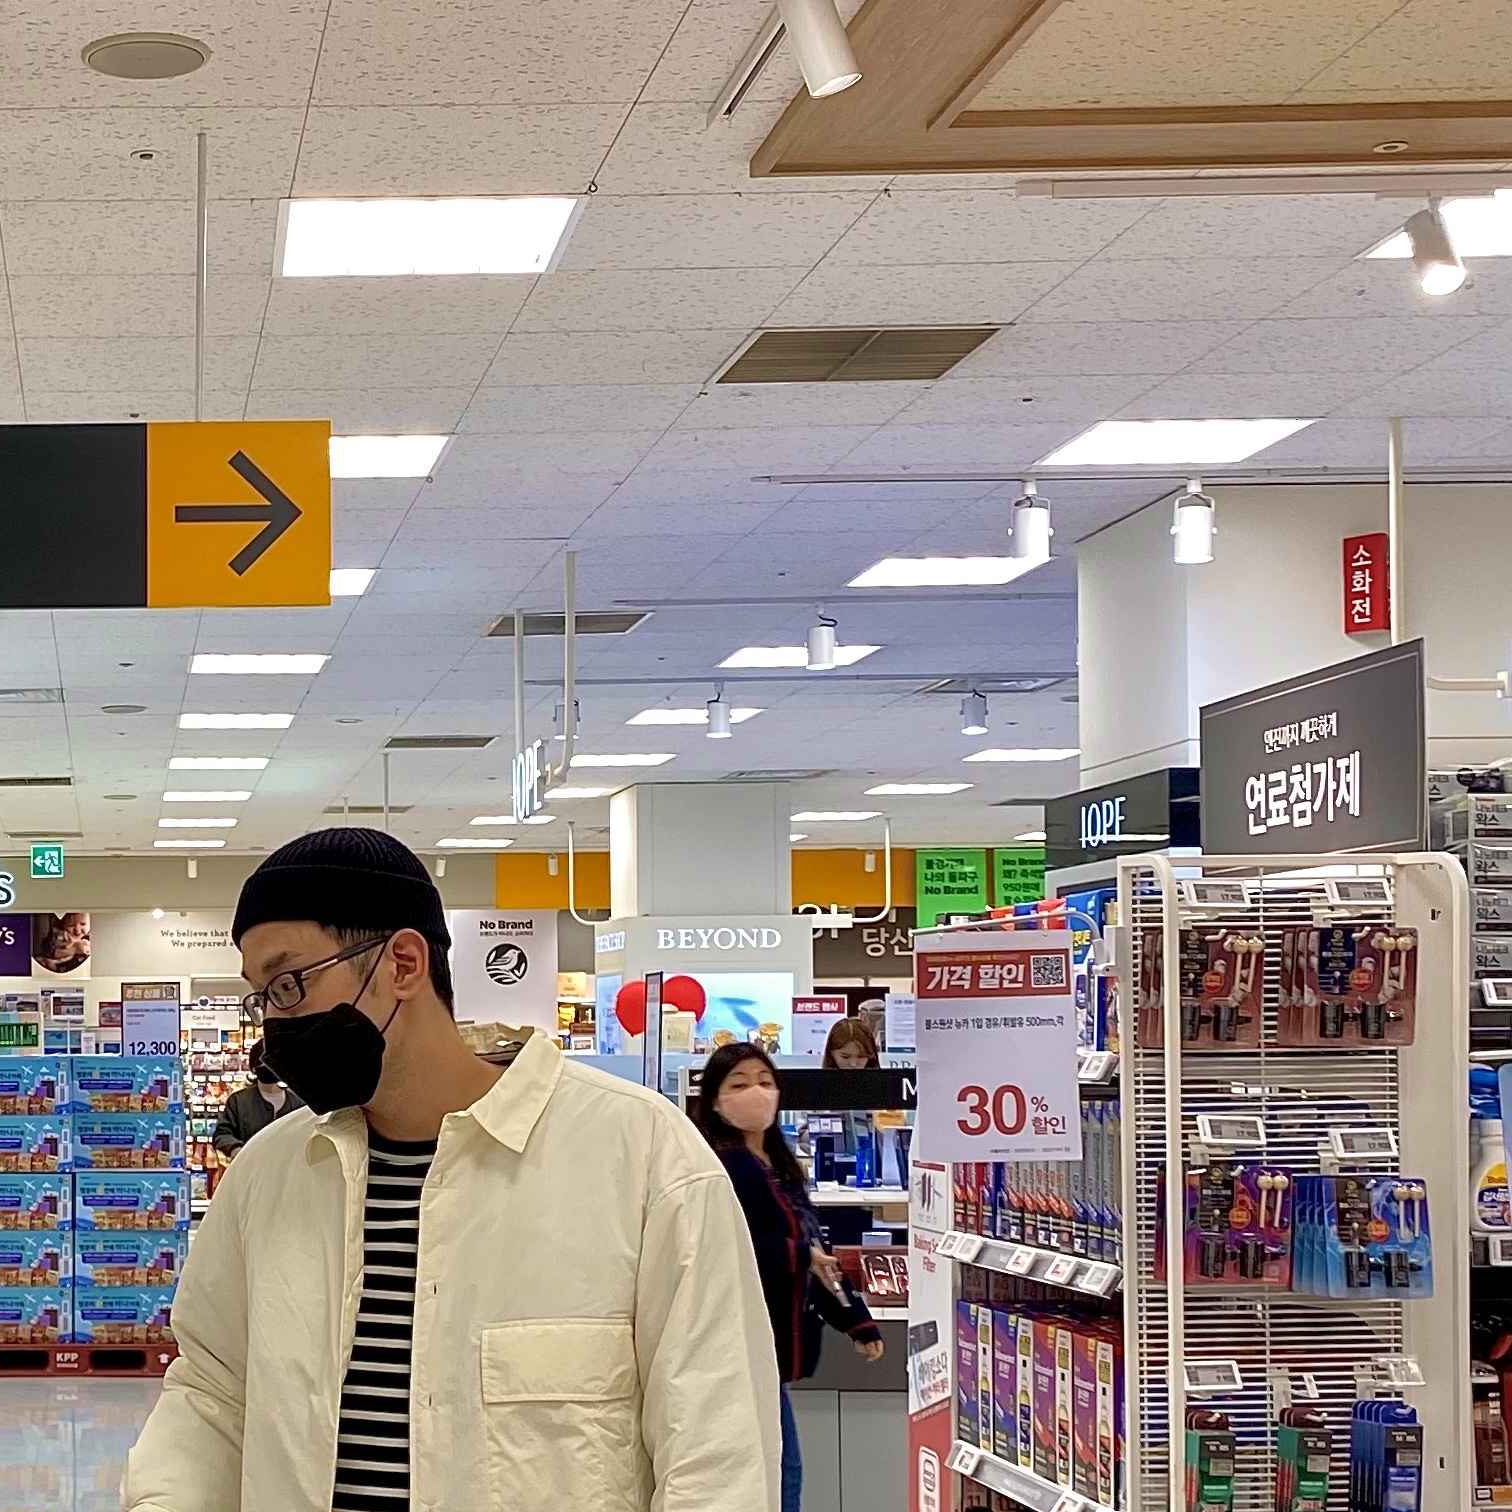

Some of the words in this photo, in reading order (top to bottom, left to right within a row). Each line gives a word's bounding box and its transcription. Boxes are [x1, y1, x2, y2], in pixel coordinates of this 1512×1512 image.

[1350, 543, 1373, 624] 소화전
[1245, 750, 1361, 836] 연료첨가제
[925, 886, 941, 894] No
[944, 886, 979, 894] Brand
[480, 920, 496, 929] No
[498, 919, 533, 929] Brand
[210, 929, 228, 937] that
[657, 927, 781, 949] BEYOND
[187, 940, 227, 949] prepared
[926, 965, 972, 990] 가격
[979, 963, 1025, 988] 할인
[129, 1041, 176, 1056] 12,300
[957, 1084, 1027, 1136] 30
[1031, 1096, 1048, 1112] %
[1031, 1116, 1066, 1135] 할인
[56, 1353, 78, 1362] KPP
